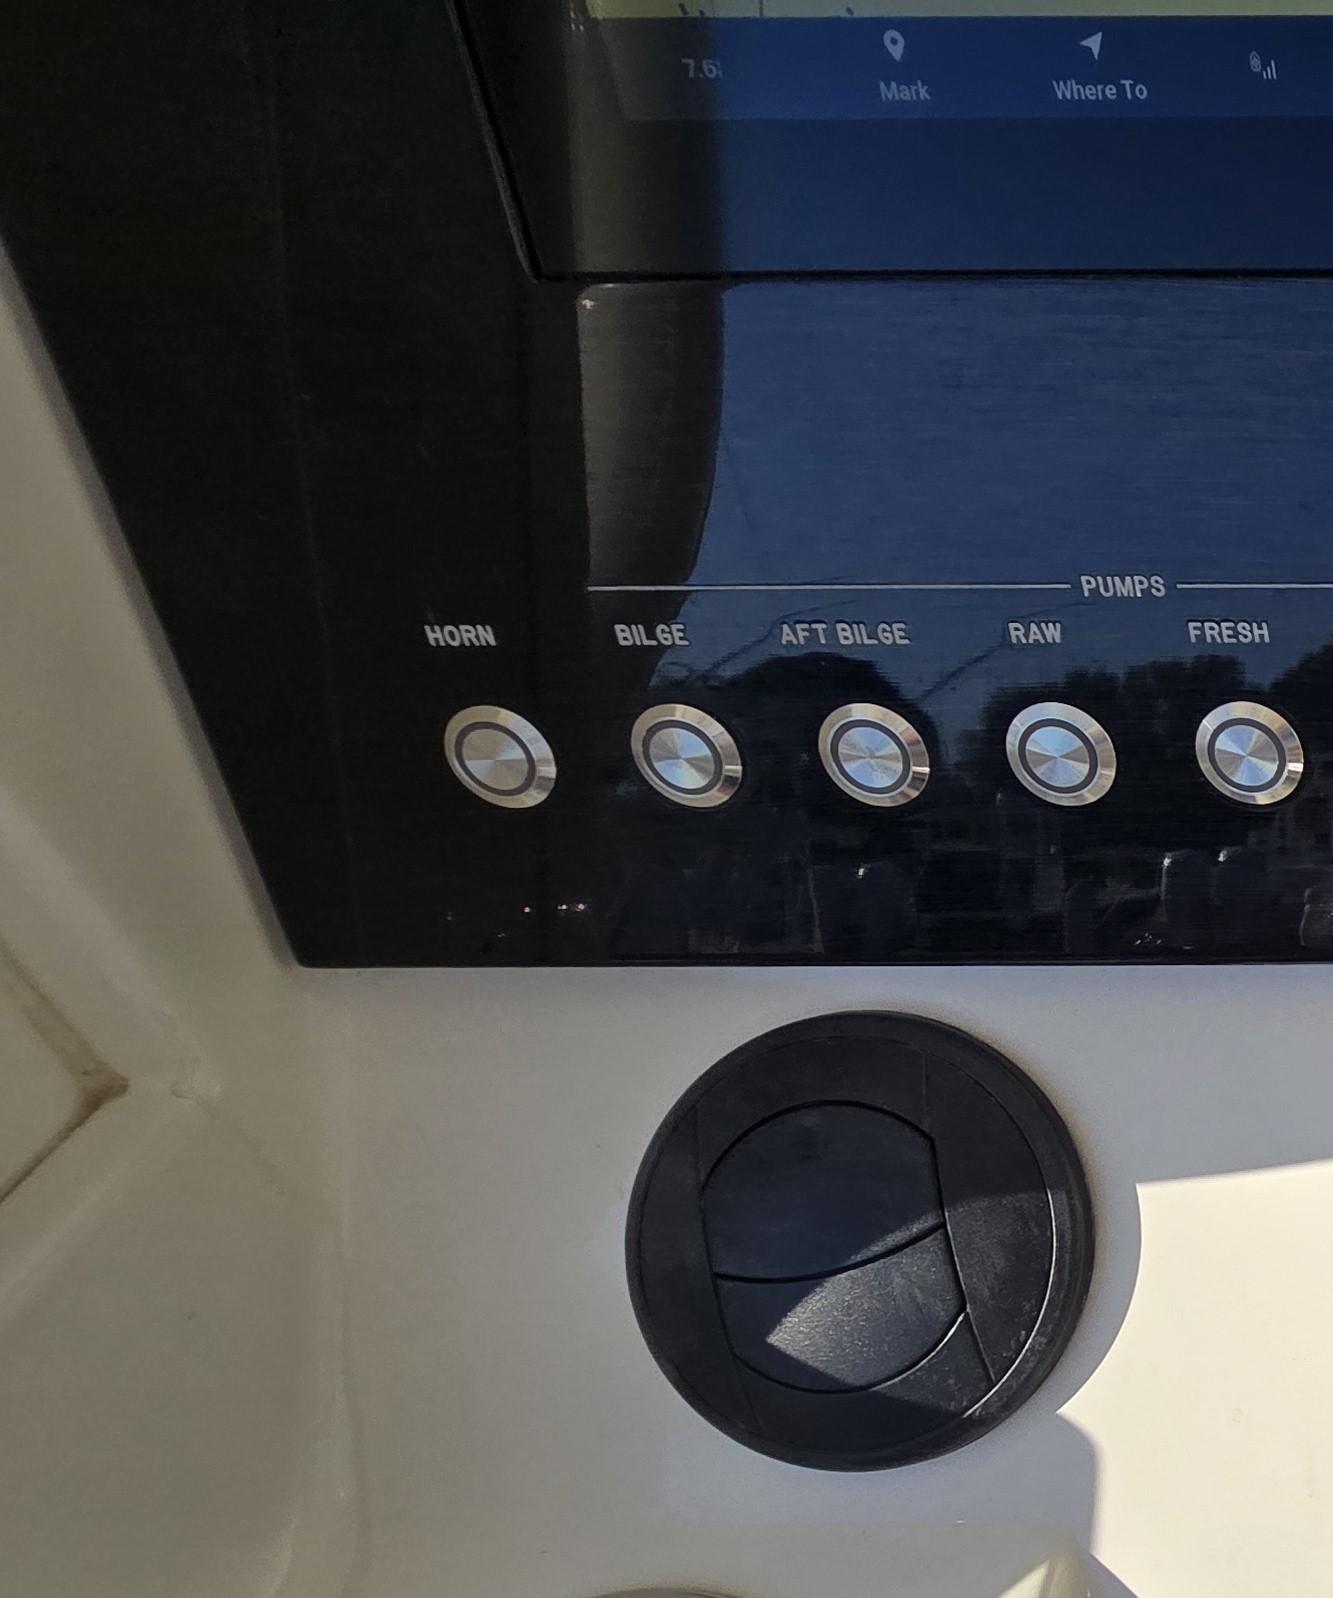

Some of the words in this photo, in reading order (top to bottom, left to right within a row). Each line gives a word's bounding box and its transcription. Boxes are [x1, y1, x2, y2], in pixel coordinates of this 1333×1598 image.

[879, 80, 931, 101] Mark
[1053, 79, 1117, 101] Where
[1120, 79, 1148, 100] To
[1080, 575, 1166, 598] PUMPS
[424, 624, 497, 647] HORN
[614, 623, 690, 647] BILGE
[780, 623, 826, 645] AFT
[835, 622, 910, 646] BILGE
[1008, 622, 1061, 644] RAW
[1188, 621, 1270, 644] FRESH
